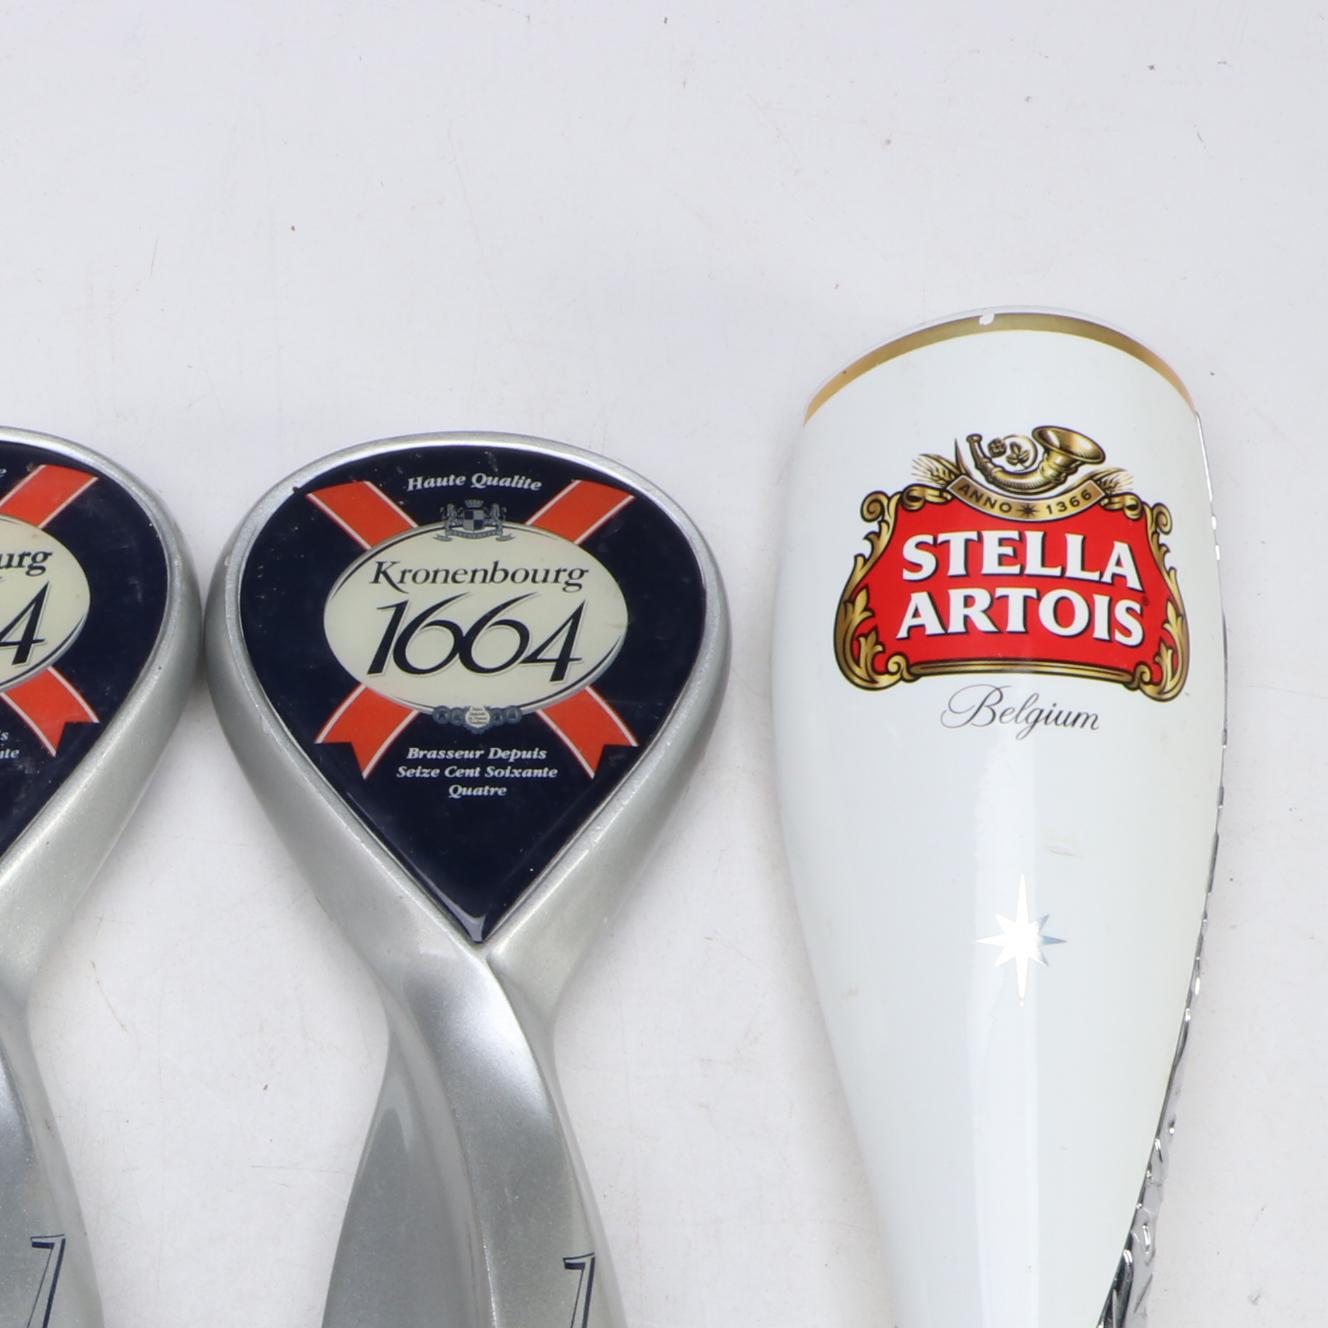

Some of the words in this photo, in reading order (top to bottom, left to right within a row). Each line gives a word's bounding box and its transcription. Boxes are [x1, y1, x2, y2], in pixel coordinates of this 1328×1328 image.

[407, 473, 466, 491] Haute
[470, 472, 542, 492] Qualite
[958, 482, 1012, 514] ANNO
[1047, 488, 1093, 515] 1366
[369, 560, 589, 594] Kronenbourg
[901, 530, 1144, 592] STELLA
[896, 586, 1144, 647] ARTOIS
[366, 591, 586, 683] 1664
[940, 683, 1100, 741] Belgium
[396, 765, 440, 778] Seize
[443, 765, 481, 778] Cent
[484, 764, 558, 778] Soixante
[407, 748, 484, 760] Brasseur
[488, 748, 548, 762] Depuis
[448, 783, 507, 798] Quatre
